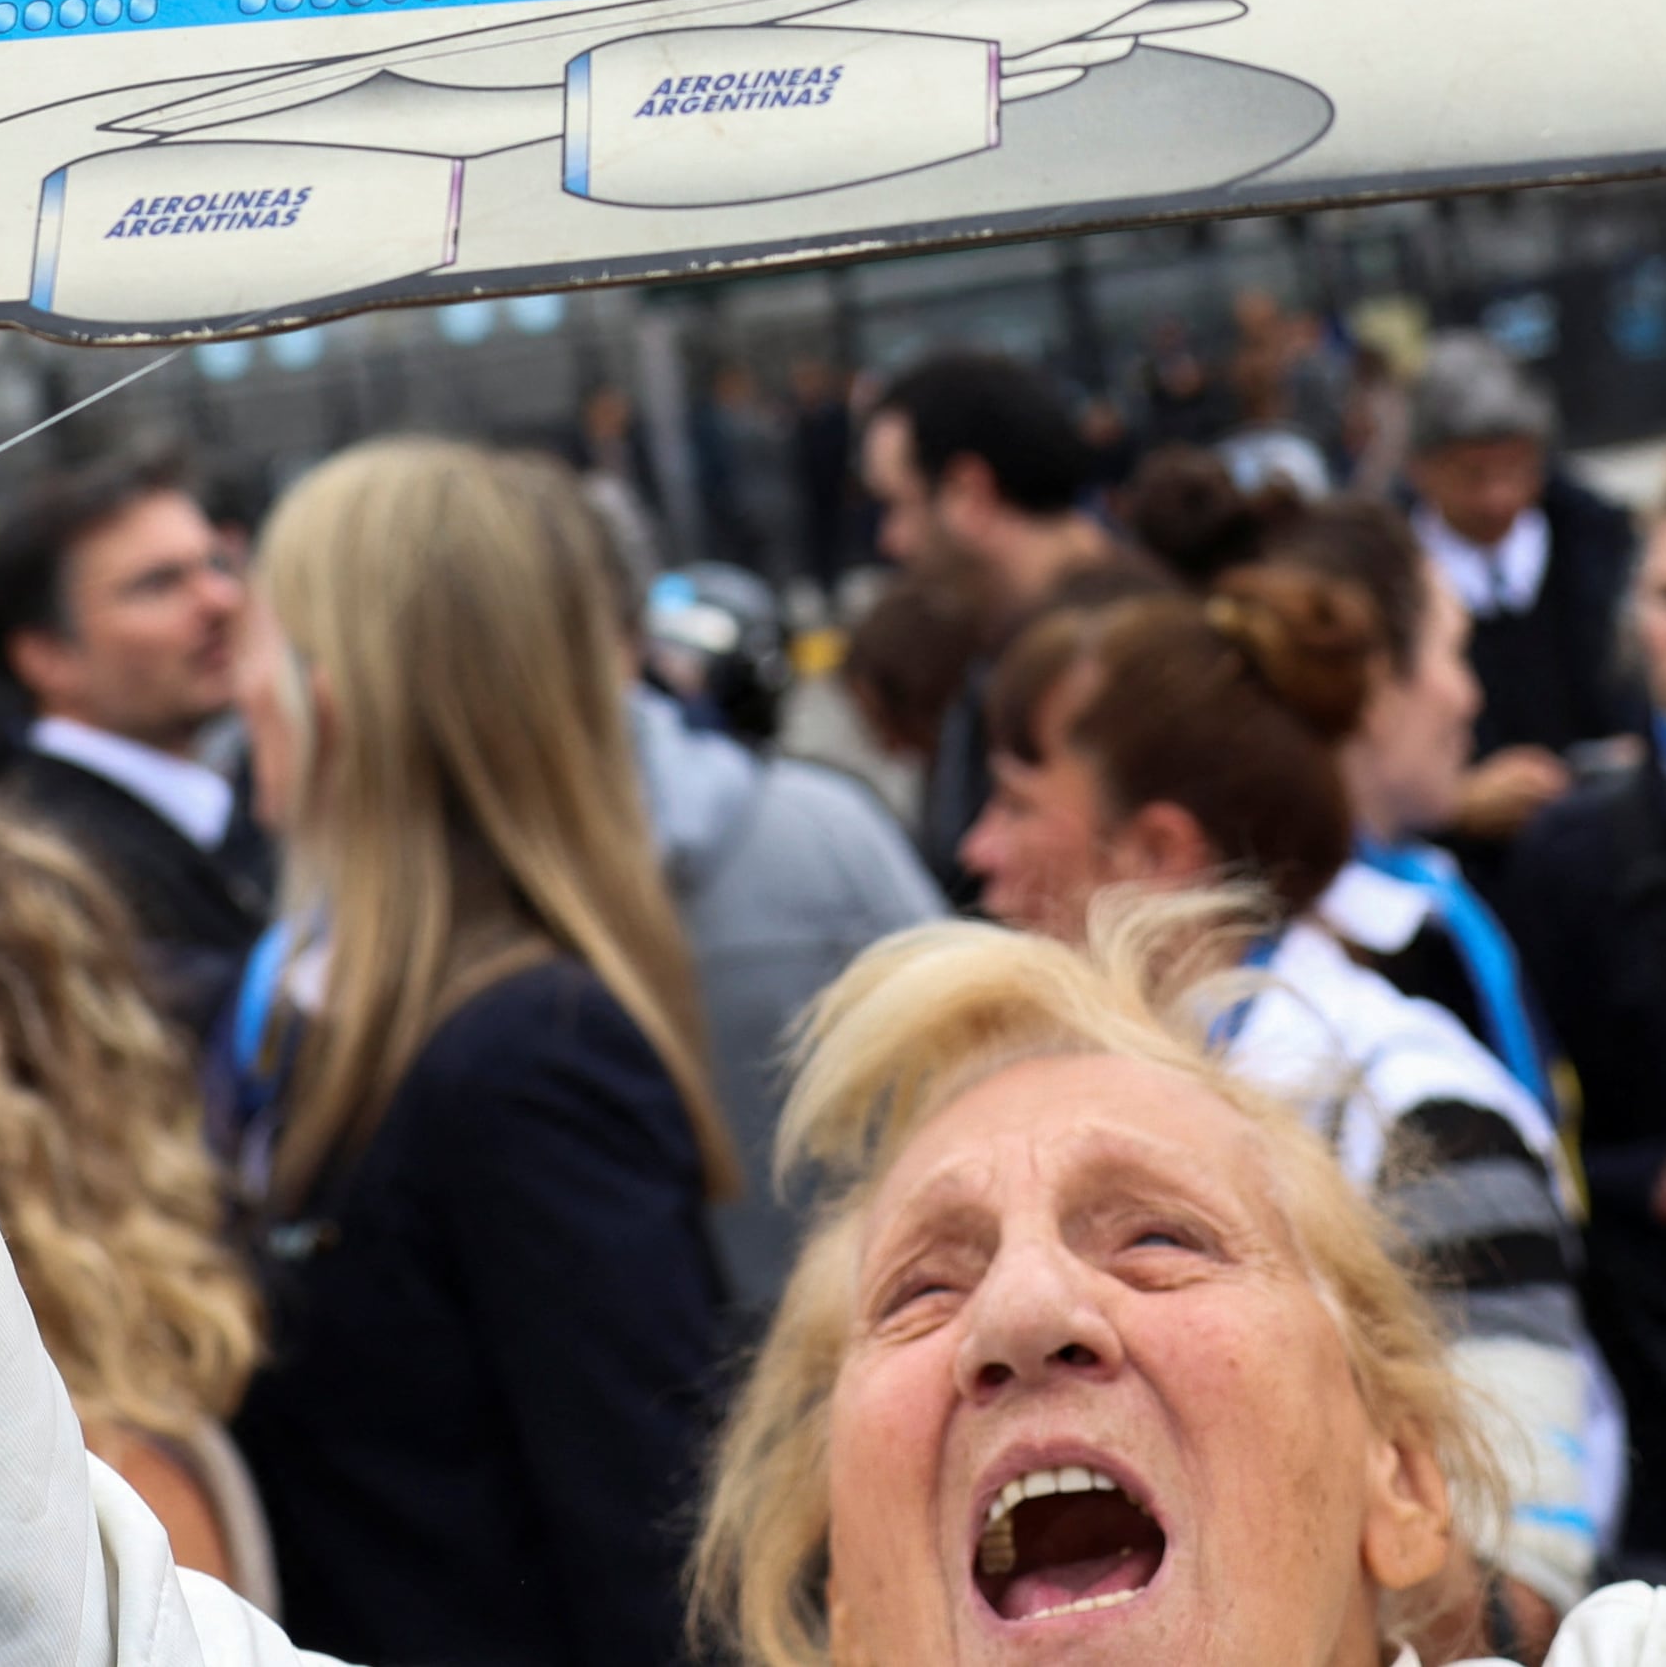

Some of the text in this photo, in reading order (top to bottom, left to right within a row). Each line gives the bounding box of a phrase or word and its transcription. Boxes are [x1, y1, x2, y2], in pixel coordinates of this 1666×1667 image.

[650, 65, 845, 98] AEROLINEAS
[634, 85, 836, 118] ARGENTINAS
[124, 185, 313, 218] AEROLINEAS
[104, 206, 301, 239] ARGENTINAS
